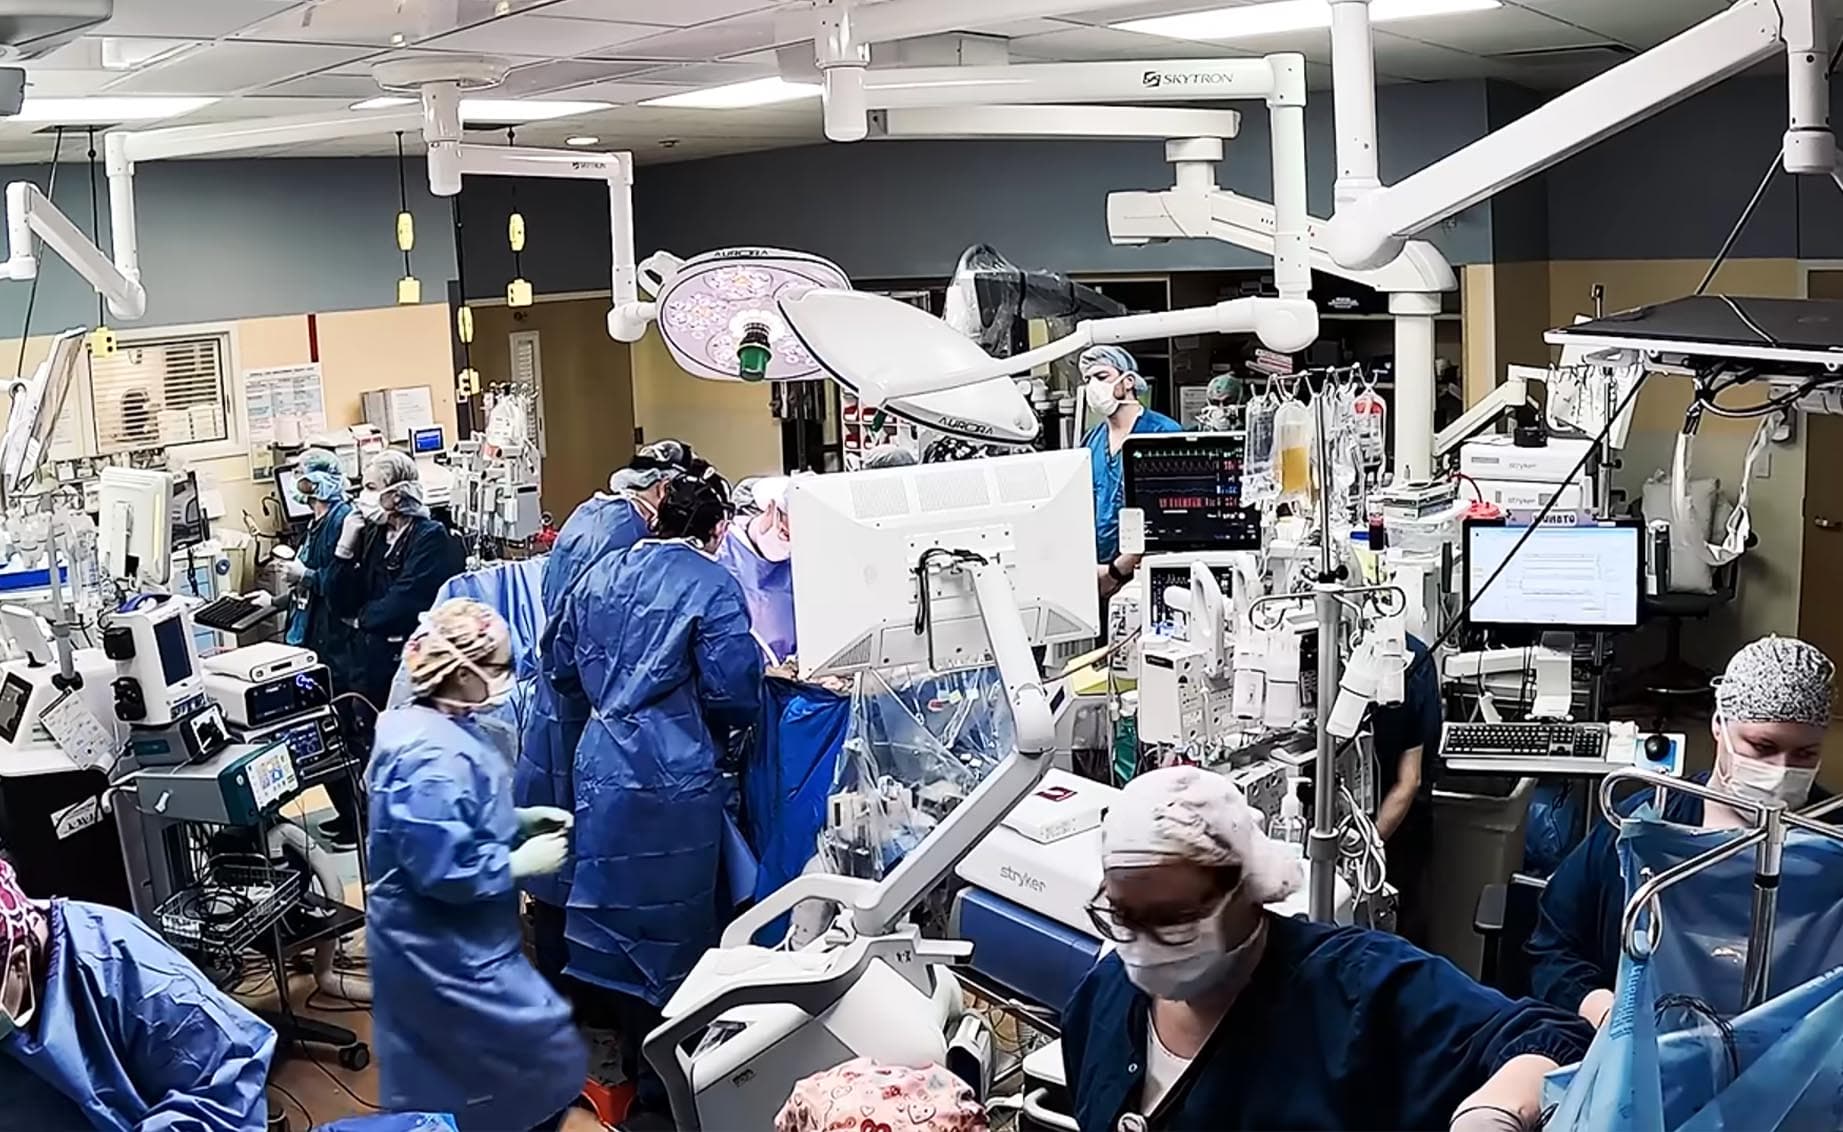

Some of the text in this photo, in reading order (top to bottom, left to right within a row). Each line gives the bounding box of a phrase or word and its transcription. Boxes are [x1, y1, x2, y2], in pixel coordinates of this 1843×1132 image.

[1163, 72, 1234, 85] SKYTRON
[938, 416, 994, 435] AURORA
[999, 865, 1046, 893] stryker
